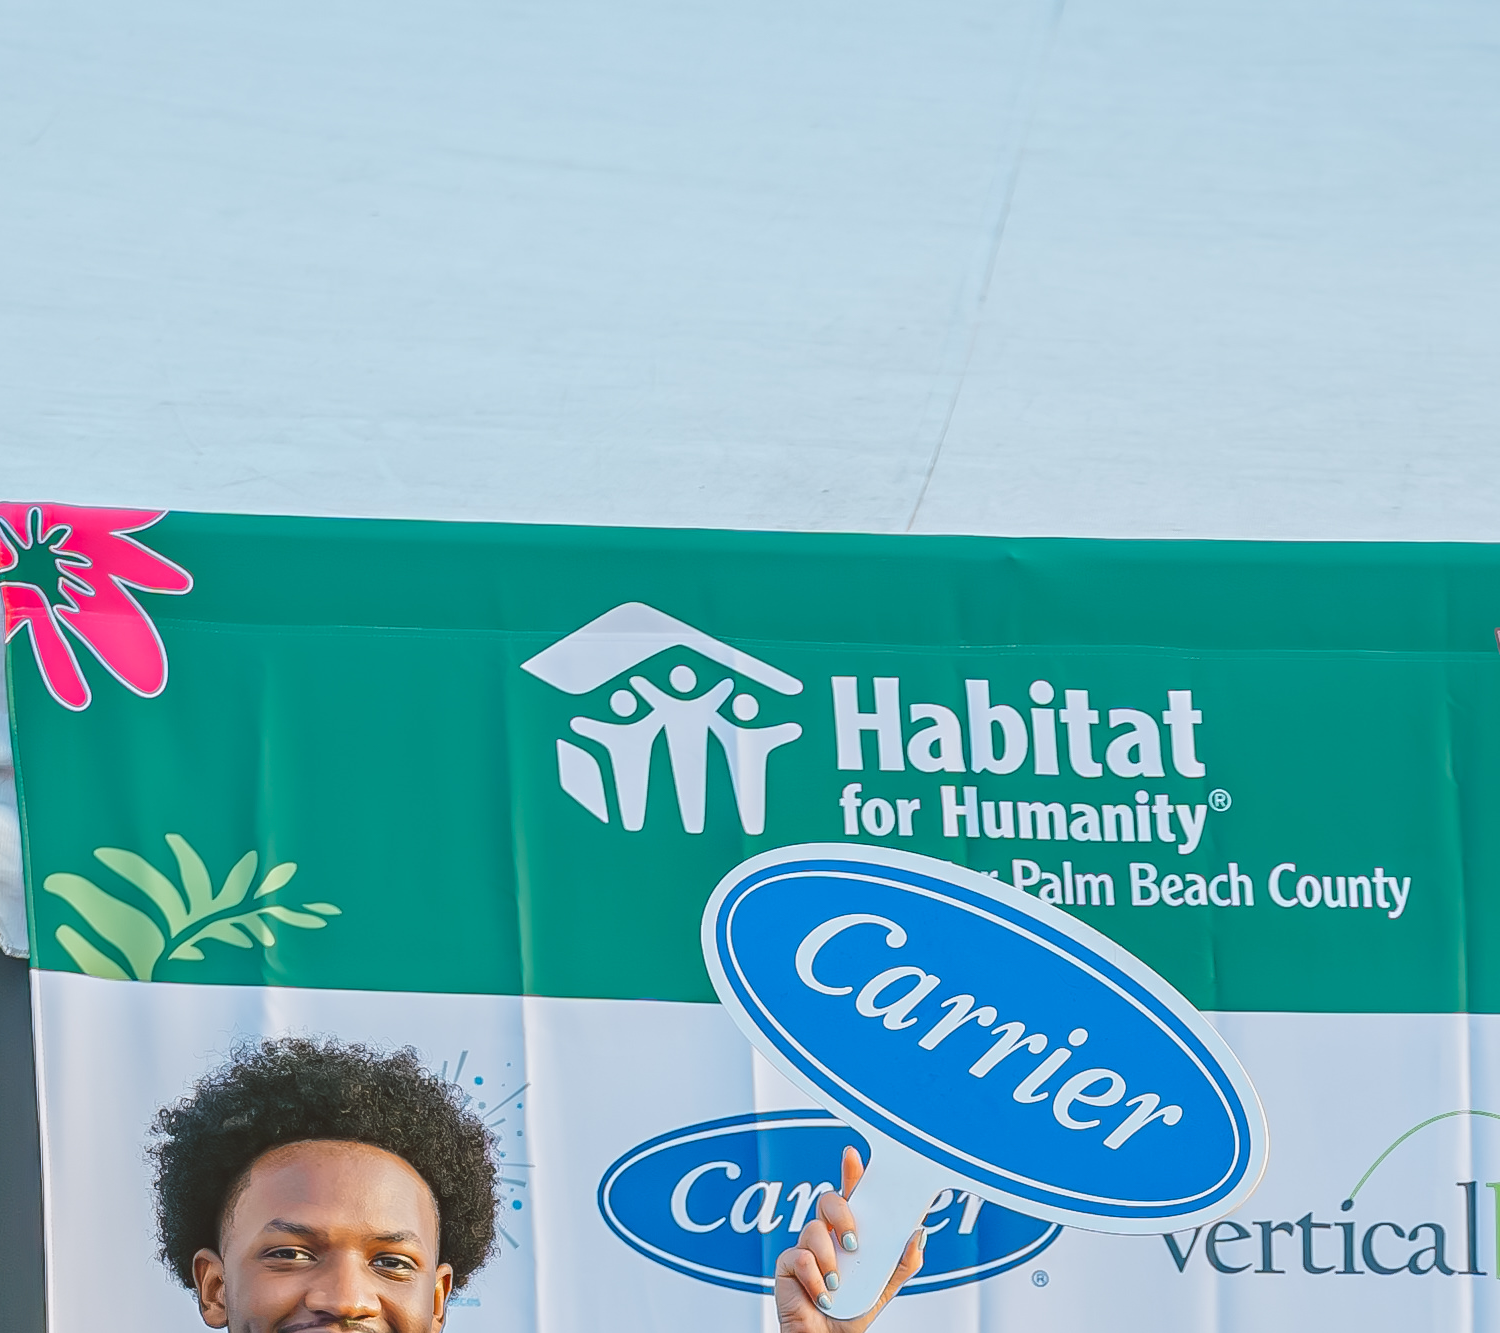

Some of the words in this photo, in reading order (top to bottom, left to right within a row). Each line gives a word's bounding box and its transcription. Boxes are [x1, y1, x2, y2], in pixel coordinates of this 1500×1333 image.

[831, 676, 1206, 777] Habitat
[840, 783, 920, 837] for
[1129, 862, 1254, 907] Beach
[1268, 863, 1412, 919] County
[794, 912, 1184, 1150] Carrier
